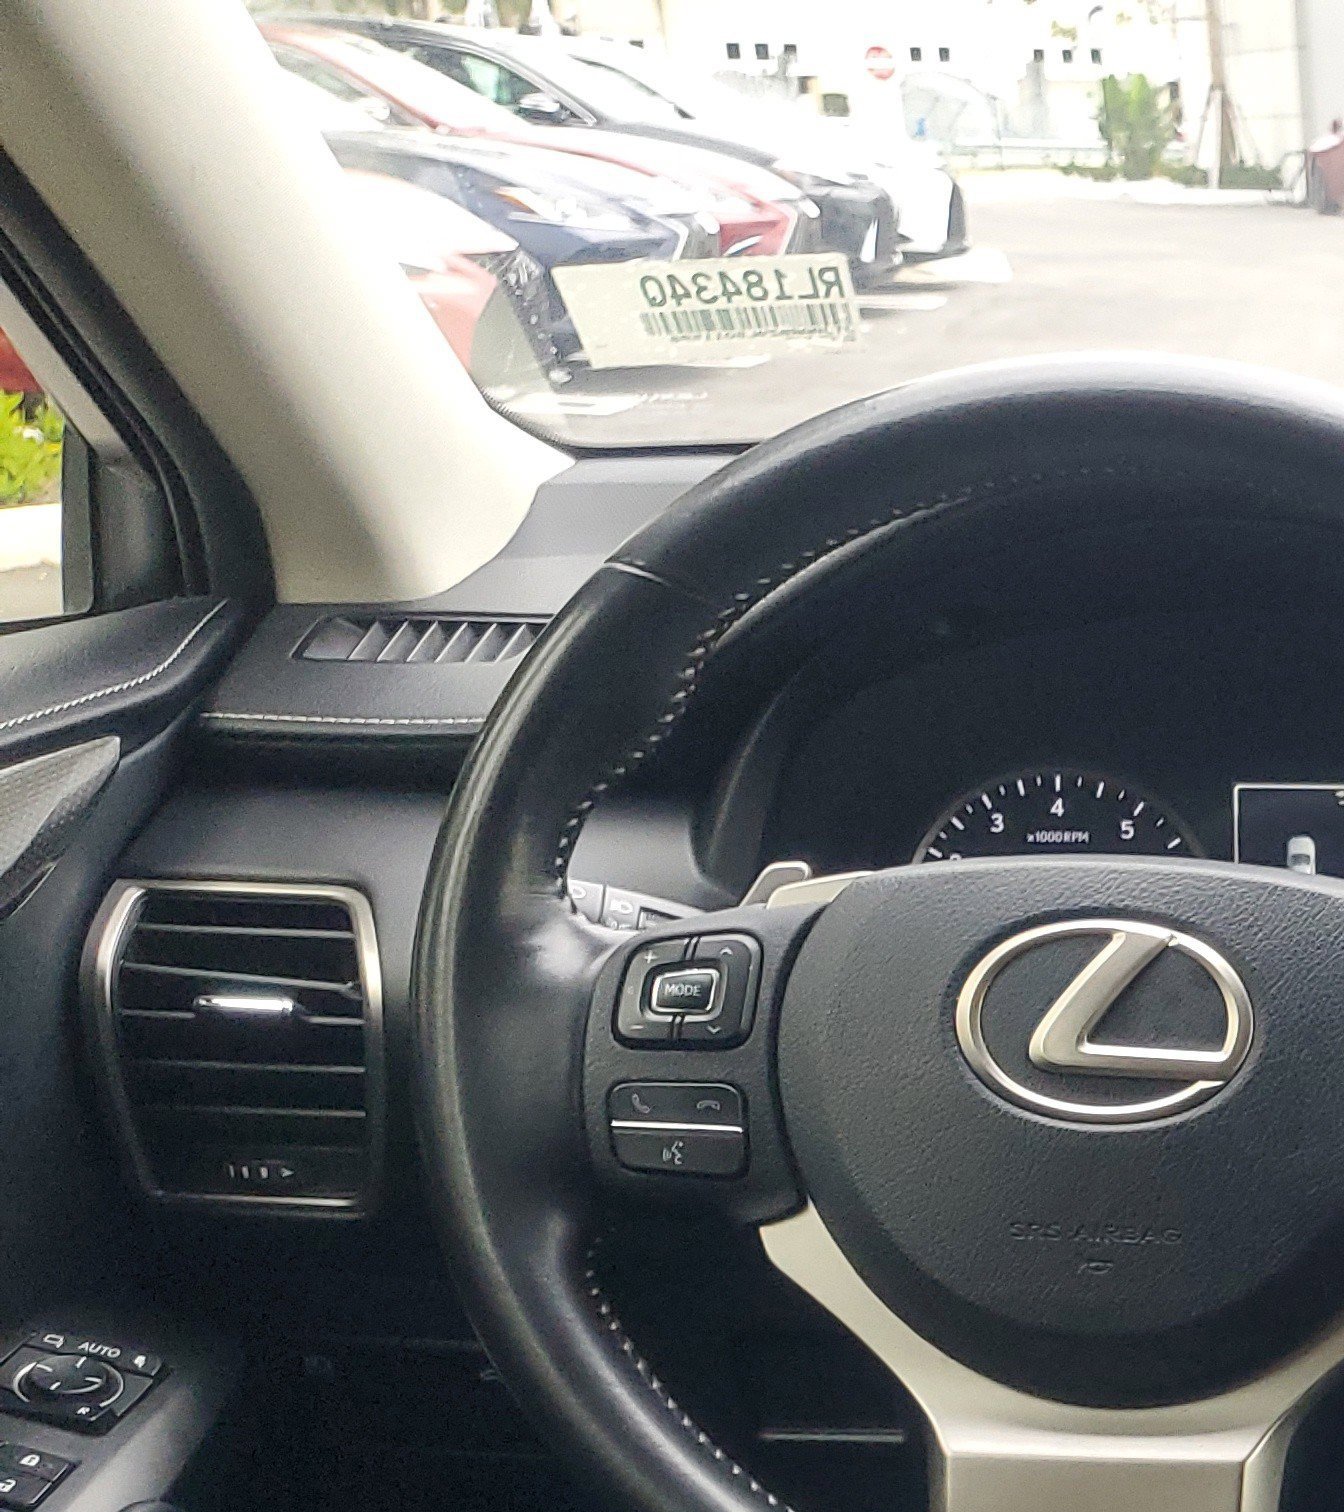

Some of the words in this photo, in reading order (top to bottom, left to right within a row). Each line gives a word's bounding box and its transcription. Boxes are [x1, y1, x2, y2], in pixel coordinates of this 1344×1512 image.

[1050, 797, 1065, 818] 4
[989, 813, 1005, 833] 3
[1120, 818, 1135, 841] 5
[664, 983, 702, 998] MODE
[78, 1341, 121, 1358] AUTO
